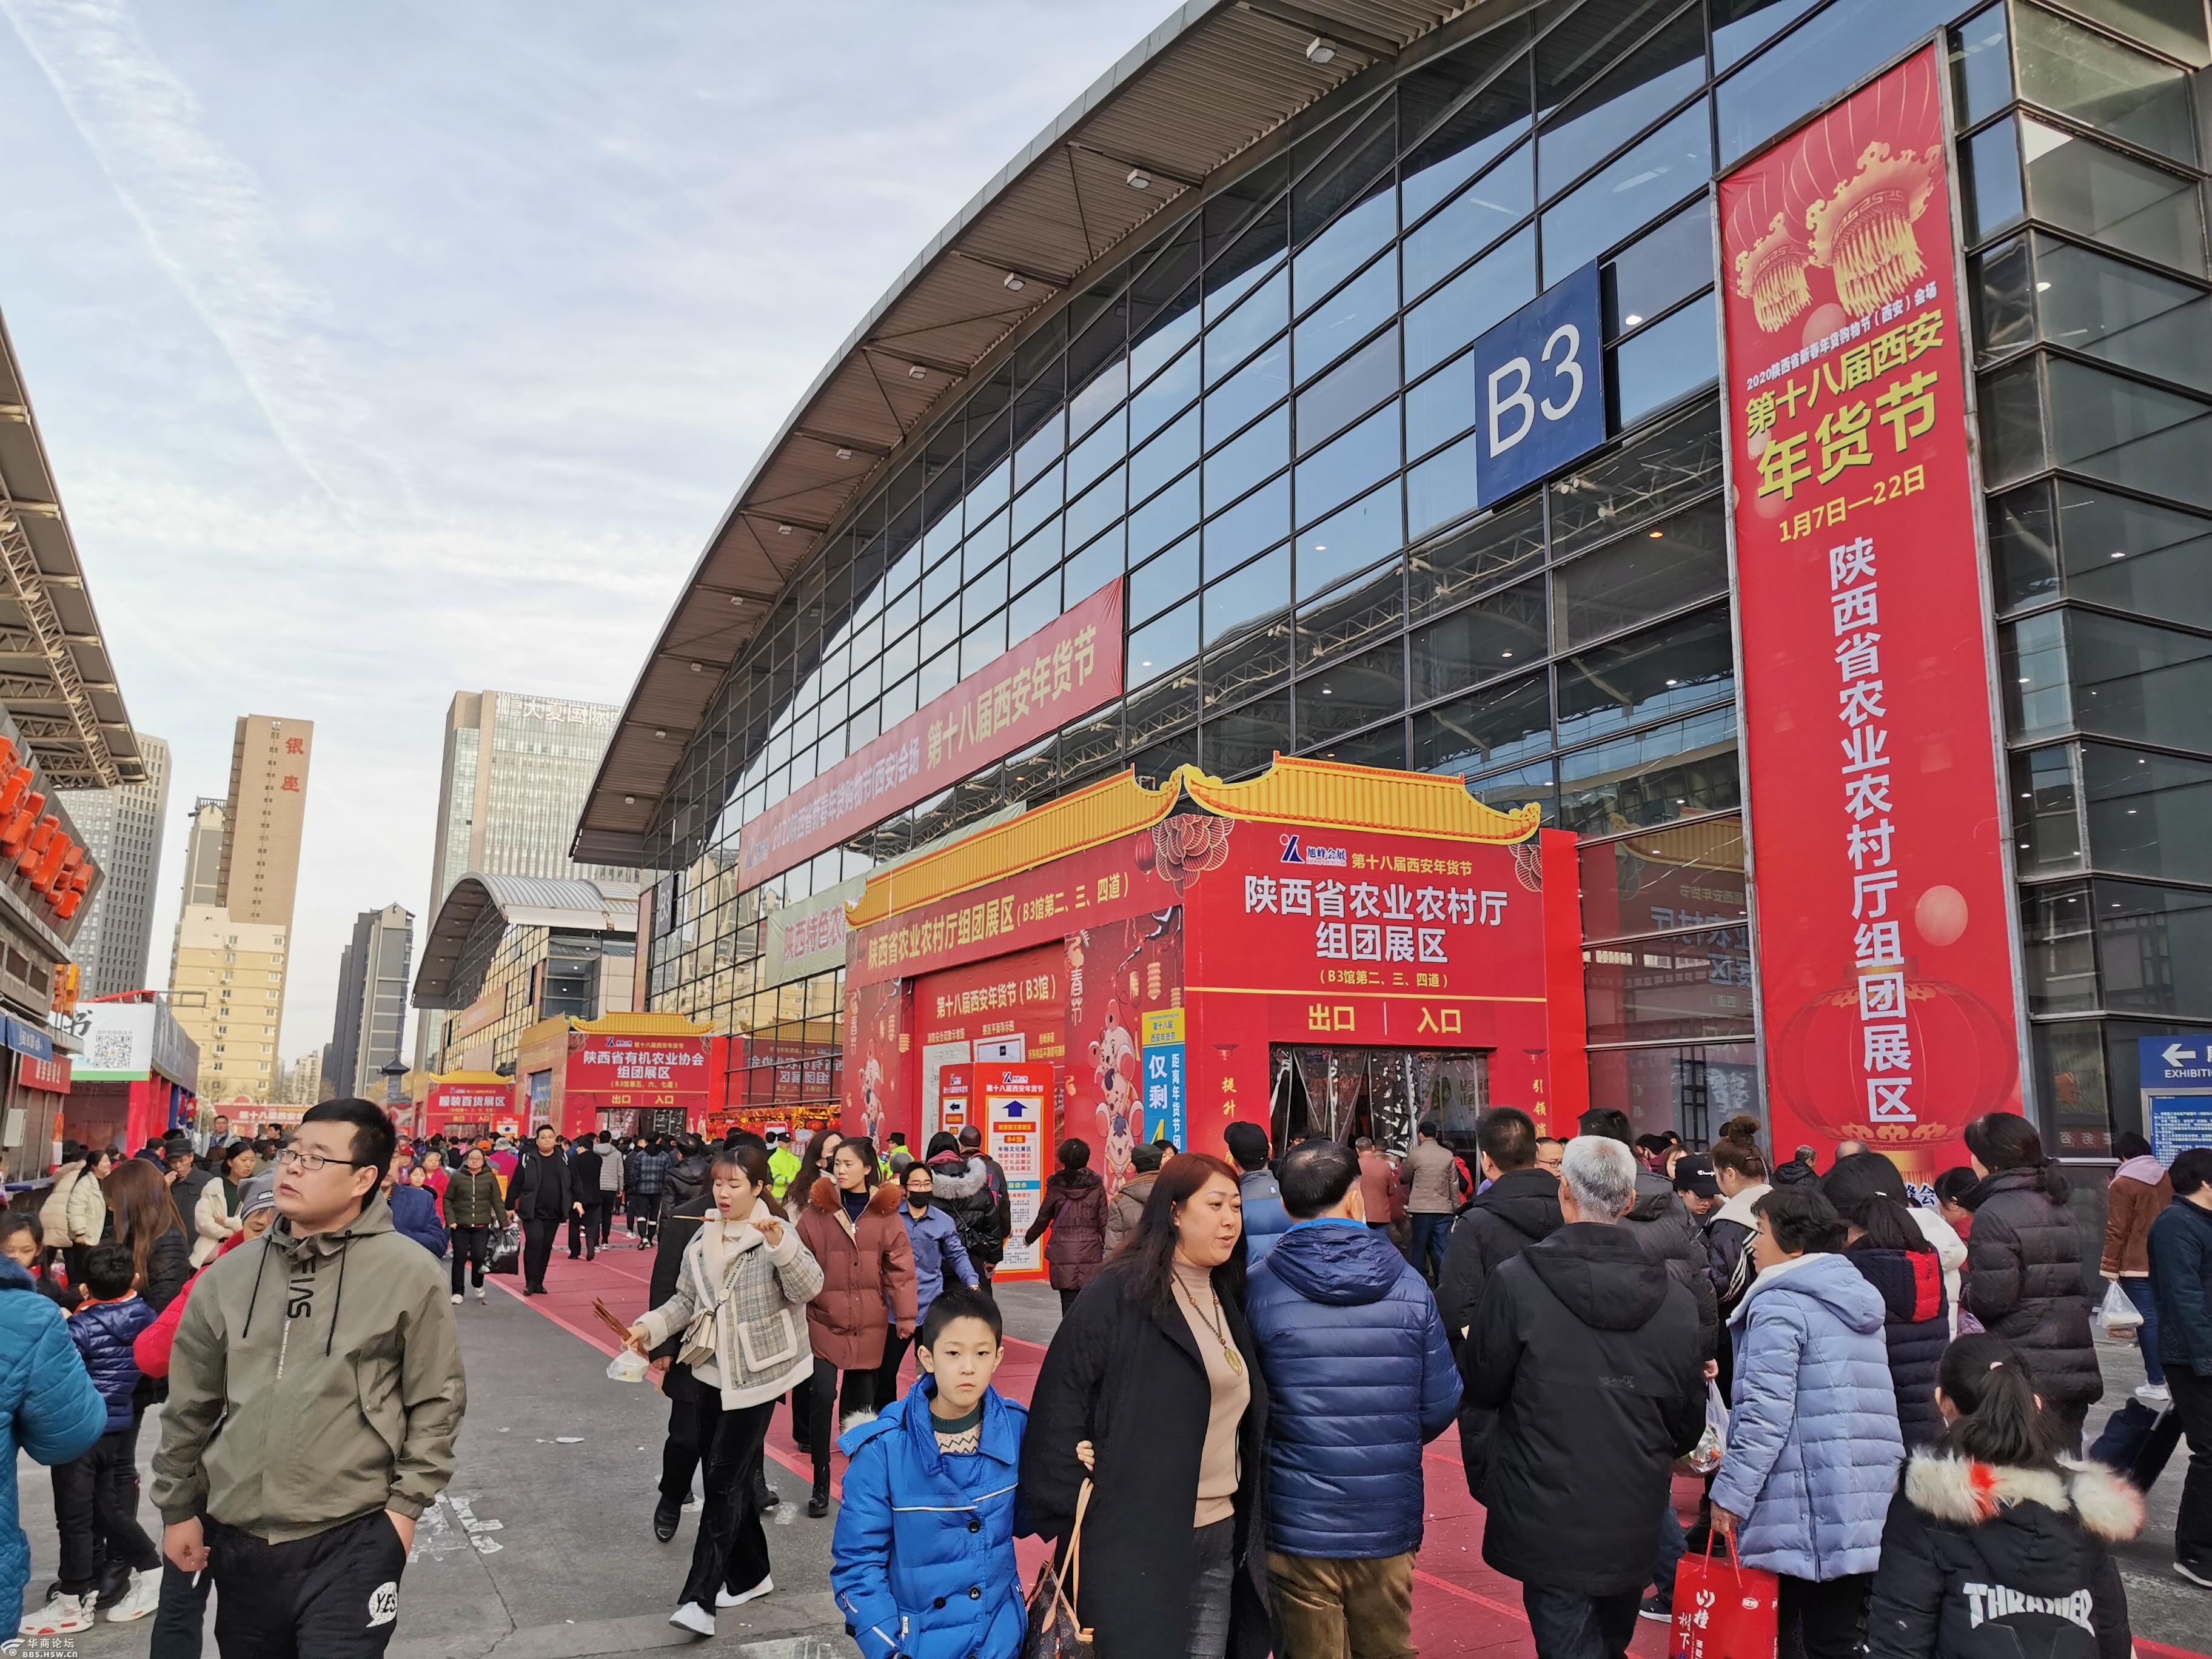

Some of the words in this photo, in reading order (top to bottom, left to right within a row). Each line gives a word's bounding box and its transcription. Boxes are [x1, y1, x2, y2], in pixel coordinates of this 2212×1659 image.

[1489, 324, 1584, 458] B3
[1745, 309, 1944, 438] 第十八届西安
[1756, 370, 1939, 501] 年货节
[927, 623, 1096, 770] 第十八届西安年货节
[280, 737, 304, 793] 银座
[1829, 536, 1917, 1123] 陕西省农业农村厅组团展区
[1352, 853, 1472, 876] 第十八届西安年货节
[1245, 875, 1508, 926] 陕西省农业农村厅
[784, 903, 846, 962] 陕西特色农
[1316, 921, 1449, 964] 组团展区
[1309, 1003, 1355, 1031] 出口
[1416, 1007, 1461, 1033] 入口
[583, 1050, 705, 1066] 陕西省有机农业协会
[617, 1065, 670, 1079] 组团展区
[1148, 1055, 1168, 1110] 仅剩
[2164, 1068, 2212, 1078] EXHIBITI
[612, 1094, 631, 1104] 出口
[655, 1095, 674, 1104] 入口
[1171, 1054, 1181, 1153] 距离年货节闭
[376, 1594, 396, 1613] YES
